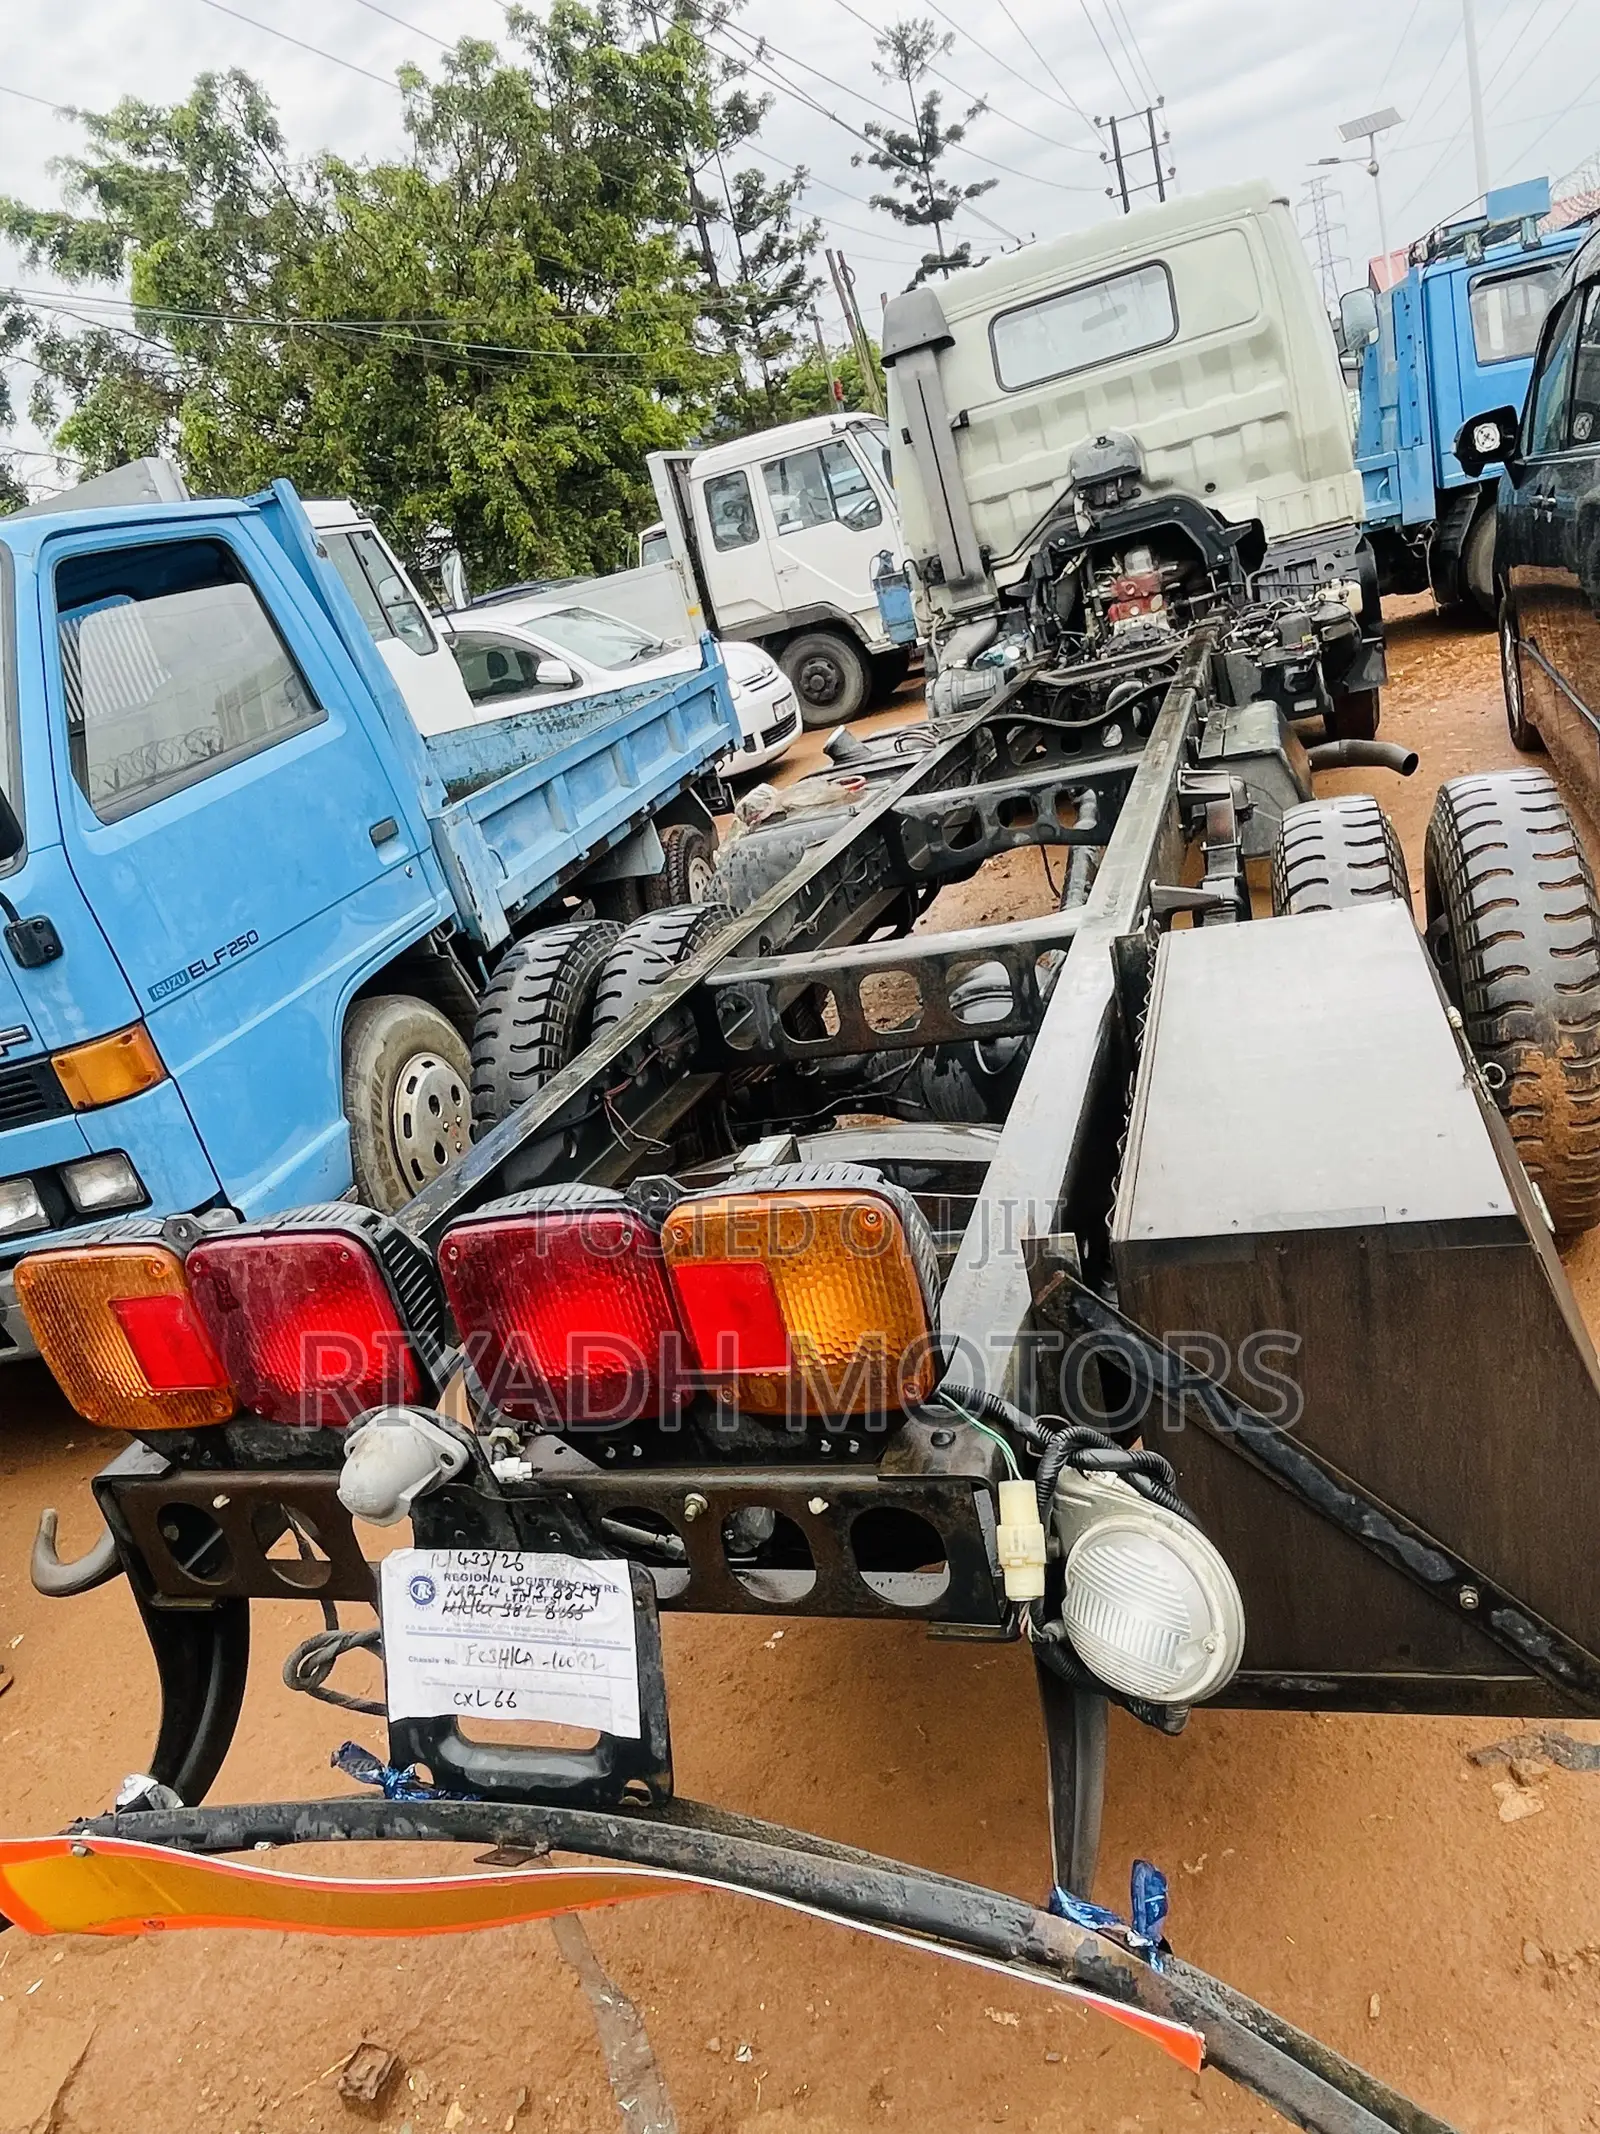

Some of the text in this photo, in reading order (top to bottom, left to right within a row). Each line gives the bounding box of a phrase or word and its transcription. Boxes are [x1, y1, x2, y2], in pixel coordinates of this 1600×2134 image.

[149, 973, 188, 1001] ISUZU
[443, 1572, 506, 1584] REGIONAL
[408, 1655, 440, 1664] Chassis
